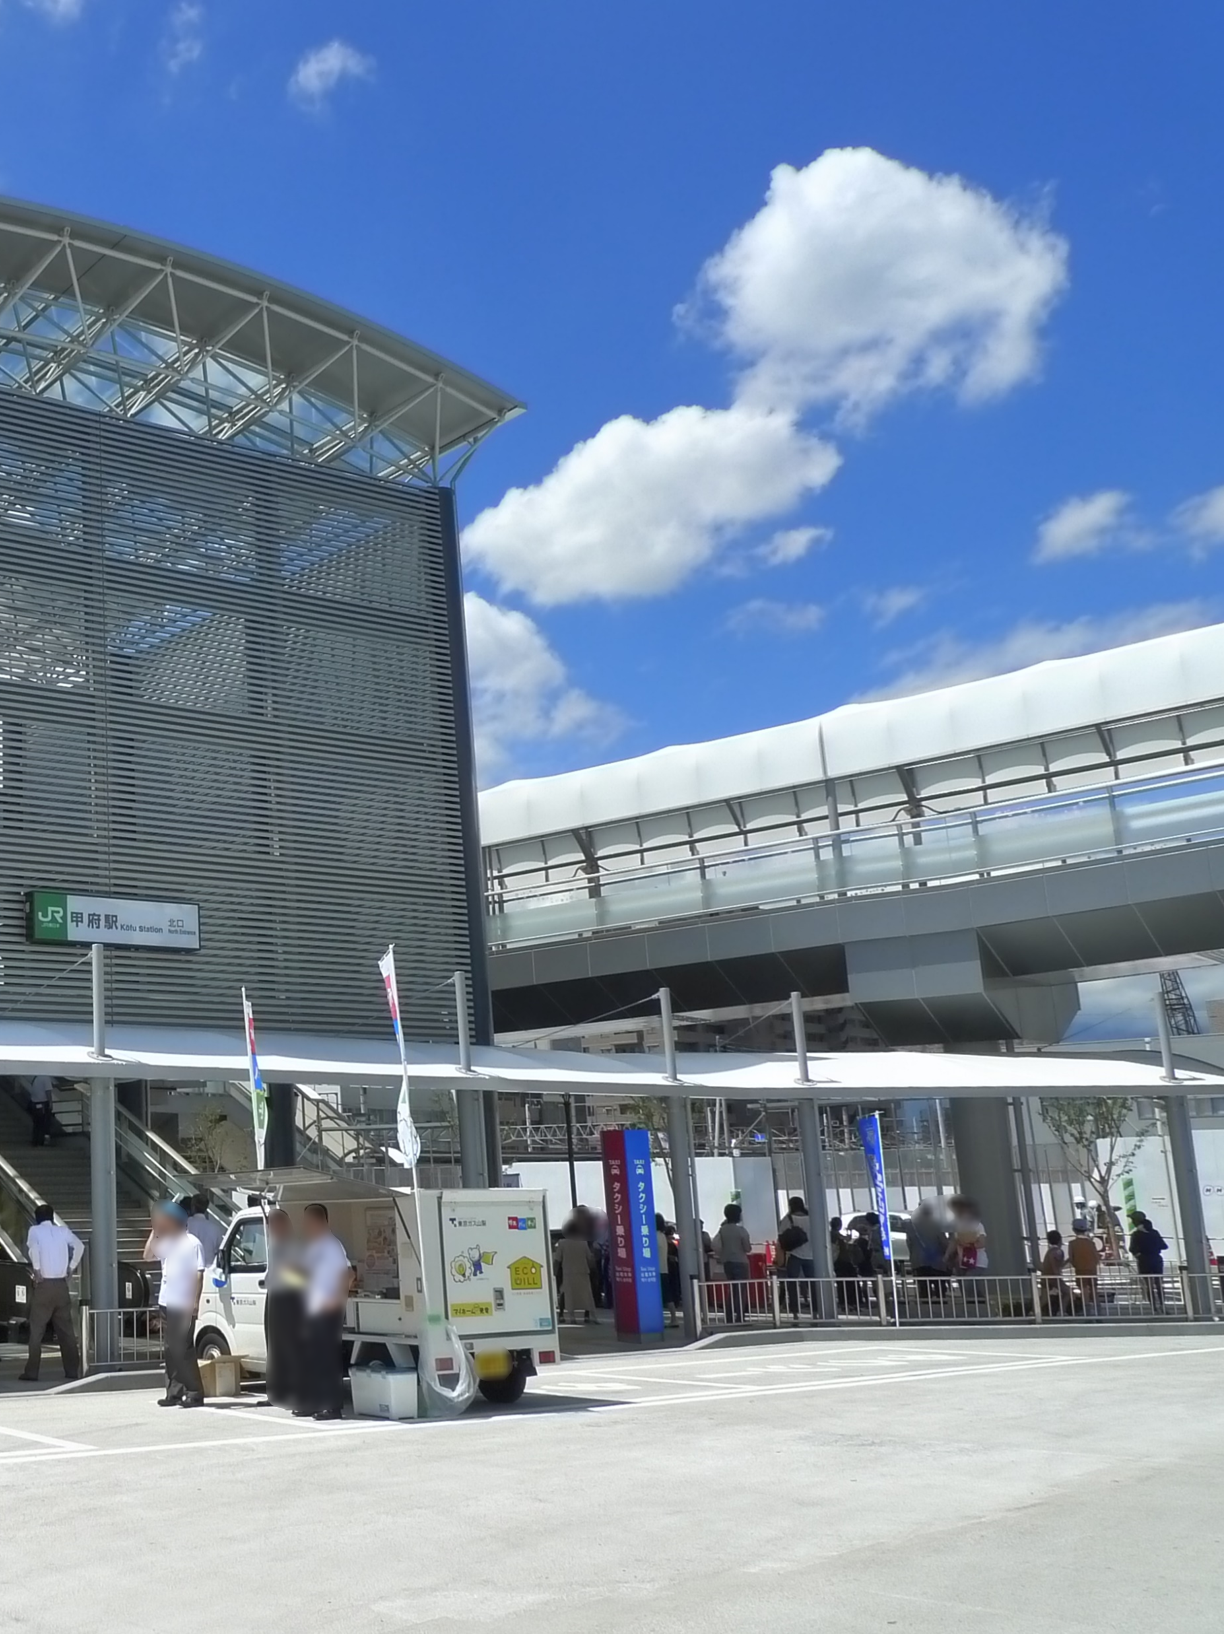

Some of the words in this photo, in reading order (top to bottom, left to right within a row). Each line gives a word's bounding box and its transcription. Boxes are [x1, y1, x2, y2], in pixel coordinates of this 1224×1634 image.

[38, 907, 63, 923] JR
[70, 911, 118, 930] 甲府駅
[168, 918, 184, 928] 北口
[139, 925, 163, 934] Station
[612, 1182, 627, 1259] タクシー乗り場
[638, 1182, 651, 1259] タクシー乗り場
[515, 1266, 537, 1275] ECO
